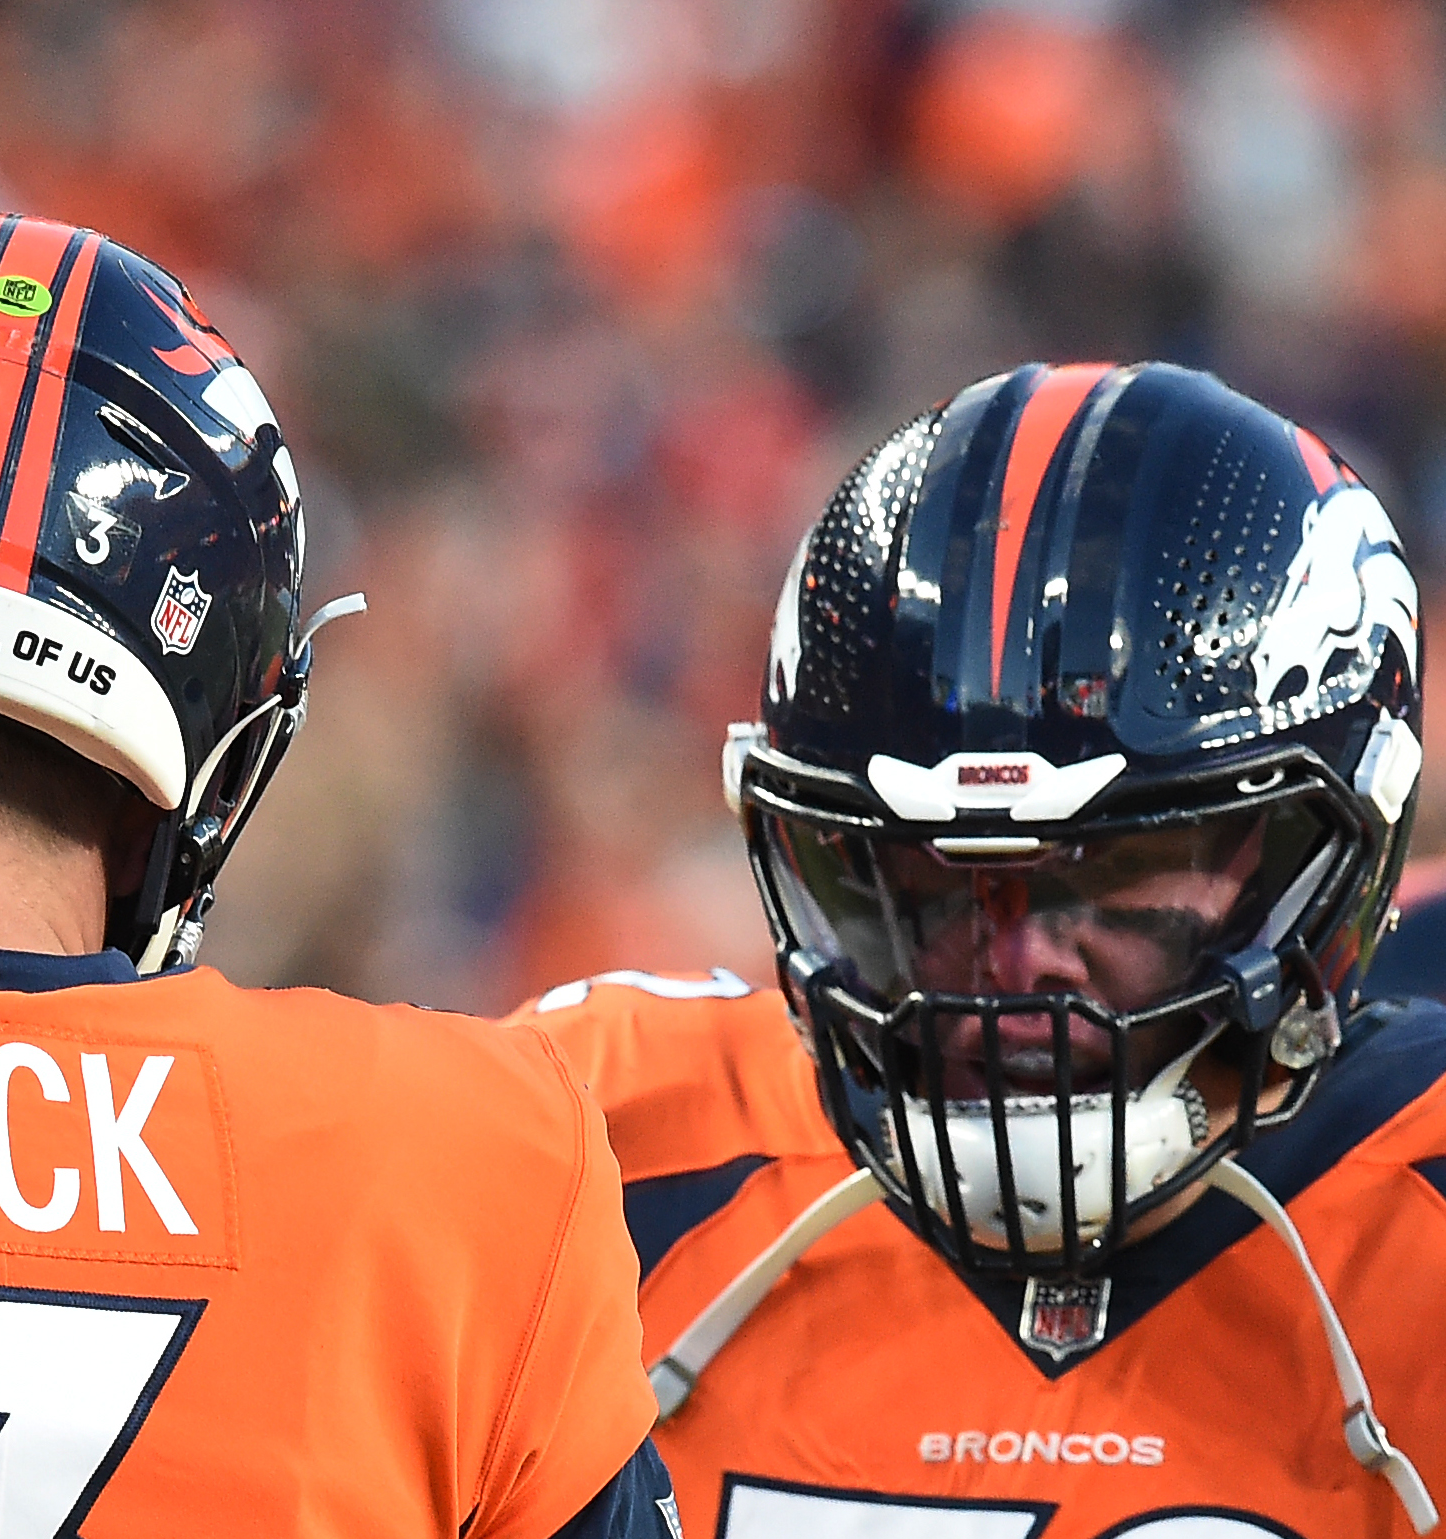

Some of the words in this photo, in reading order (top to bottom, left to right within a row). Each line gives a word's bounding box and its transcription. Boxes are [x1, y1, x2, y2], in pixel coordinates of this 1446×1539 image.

[75, 505, 119, 566] 3
[158, 598, 194, 645] NFL
[11, 629, 64, 666] OF
[67, 651, 118, 696] US
[957, 764, 1030, 785] BRONCOS
[918, 1430, 1166, 1467] BRONCOS
